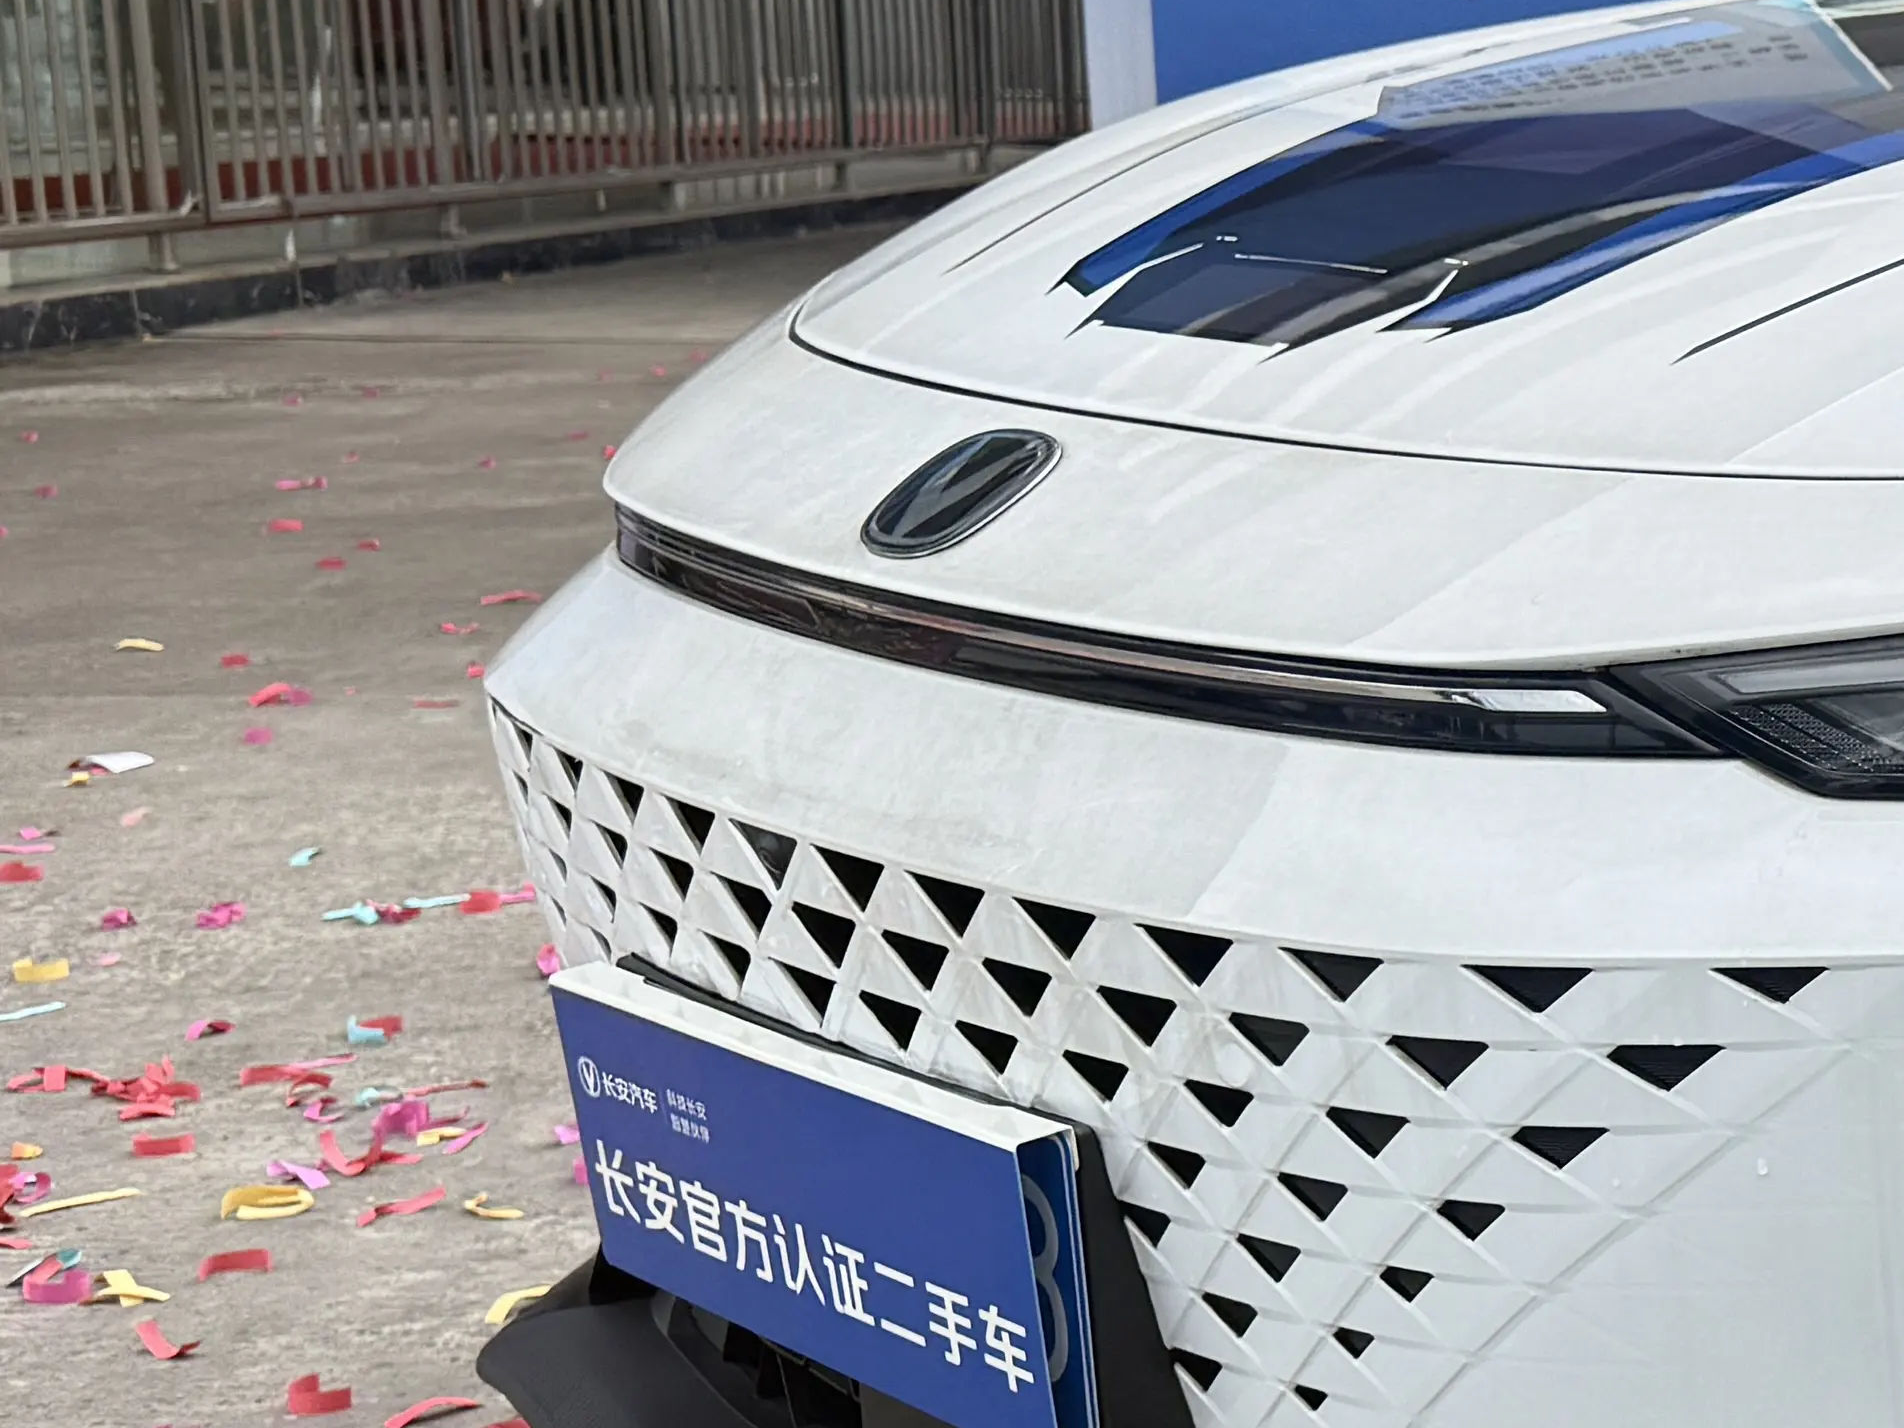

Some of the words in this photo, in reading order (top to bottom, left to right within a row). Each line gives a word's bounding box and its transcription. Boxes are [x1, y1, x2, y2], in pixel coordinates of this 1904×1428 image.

[602, 1071, 658, 1114] 长安汽车
[594, 1138, 1035, 1394] 长安官方认证二手车
